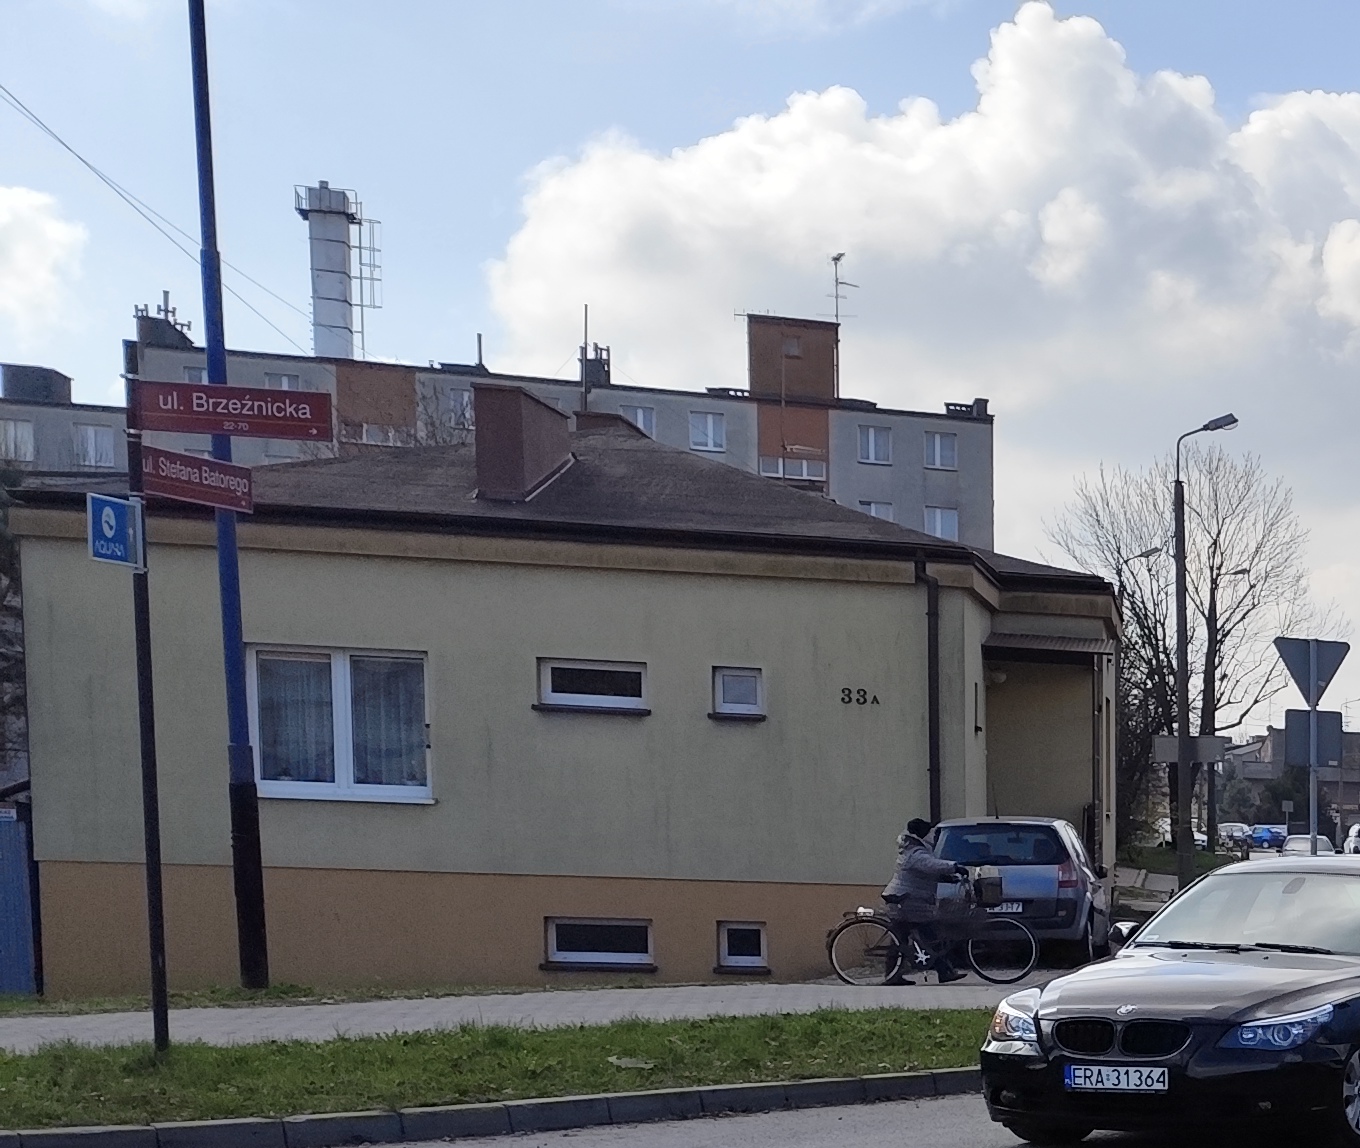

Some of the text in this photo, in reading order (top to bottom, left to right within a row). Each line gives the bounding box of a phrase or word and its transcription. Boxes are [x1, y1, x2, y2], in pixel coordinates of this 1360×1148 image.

[159, 391, 312, 419] ul. Brzeźnicka
[142, 455, 249, 496] ul. Stefana Batorego
[1072, 1067, 1105, 1087] ERA
[1111, 1068, 1166, 1088] 31364
